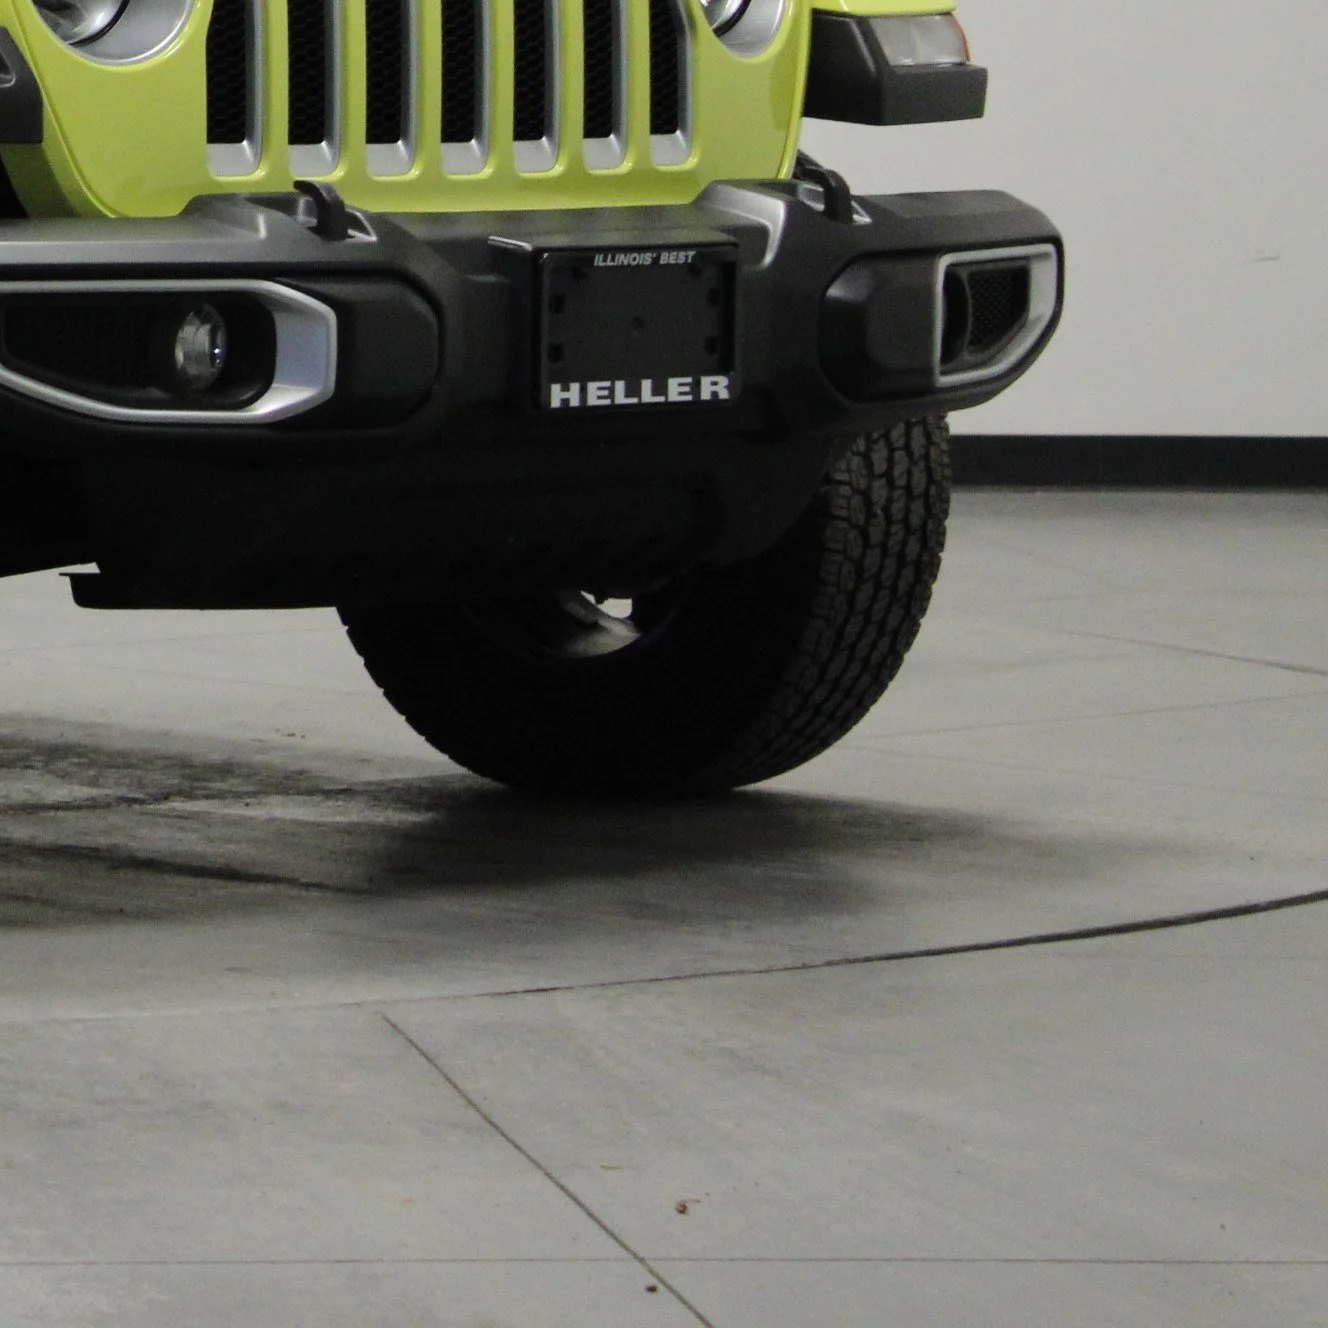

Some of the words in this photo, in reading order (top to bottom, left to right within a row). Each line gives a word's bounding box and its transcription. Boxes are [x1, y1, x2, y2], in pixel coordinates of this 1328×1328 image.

[593, 252, 657, 267] ILLINOIS'
[659, 250, 696, 265] BEST
[550, 374, 731, 409] HELLER
